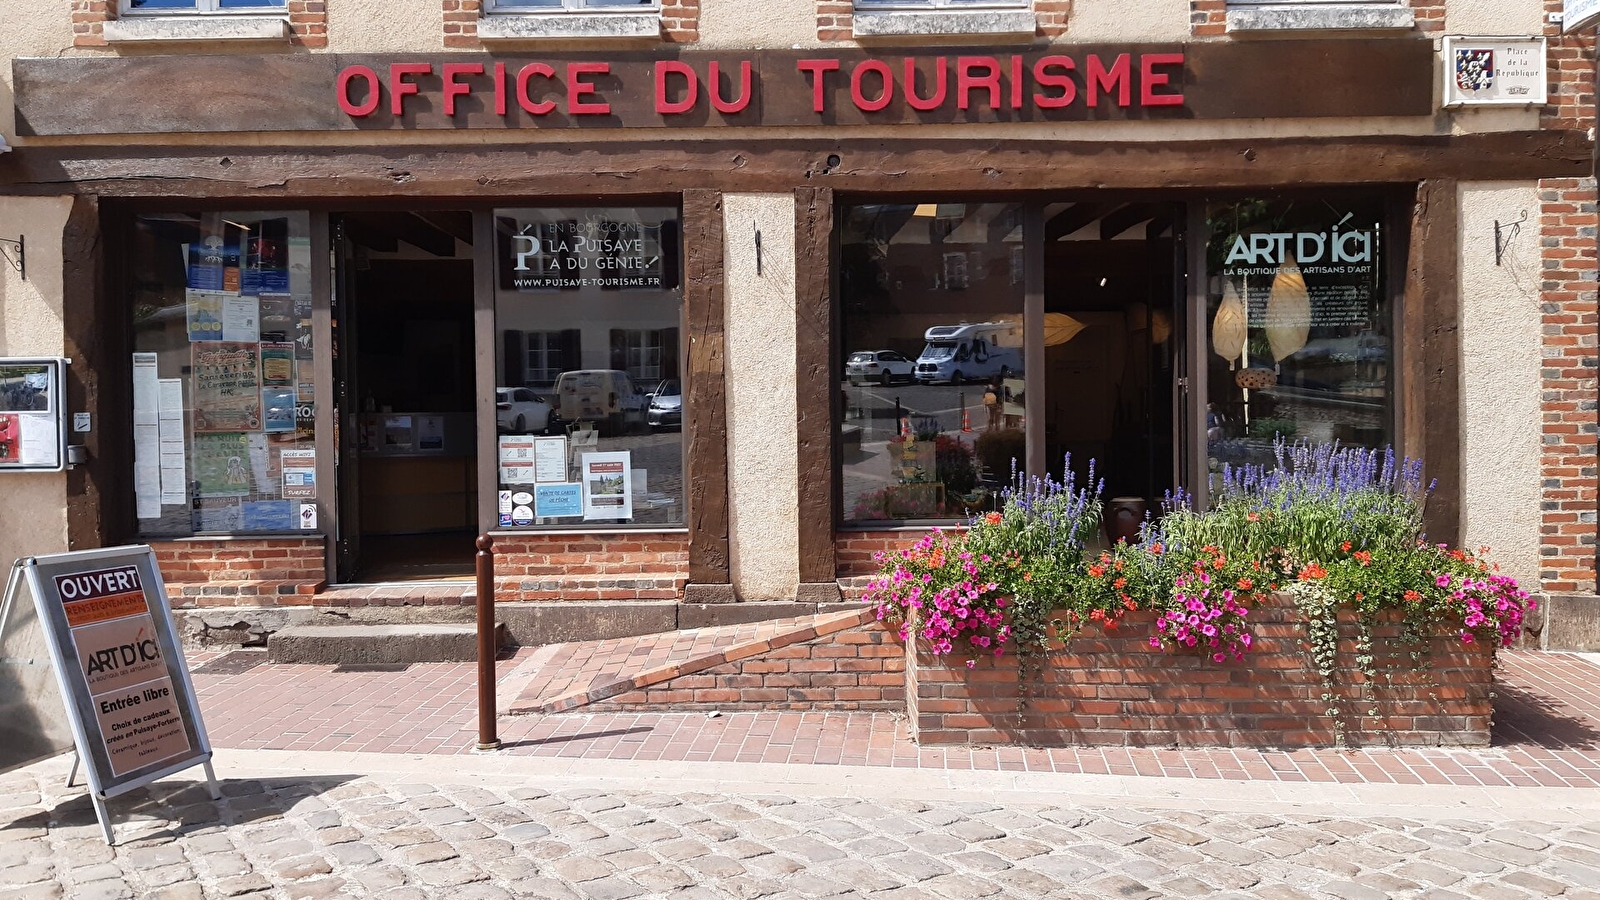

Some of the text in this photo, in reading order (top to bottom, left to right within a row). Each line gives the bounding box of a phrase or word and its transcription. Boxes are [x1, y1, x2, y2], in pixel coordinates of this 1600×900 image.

[1507, 47, 1528, 55] Place
[336, 53, 1184, 117] OFFICE DU TOURISME
[549, 222, 641, 233] EN BOURGOGNE
[549, 239, 569, 253] LA
[1224, 232, 1293, 265] ART
[549, 256, 561, 269] A
[566, 256, 588, 269] DU
[1223, 265, 1371, 276] LA BOUTIQUE DES ARTISANS D'ART
[513, 277, 660, 287] WWW.PUISAYE-TOURISME.FR
[61, 569, 138, 599] OUVERT
[87, 646, 120, 676] ART
[96, 672, 120, 683] BOUTIQUE
[100, 687, 170, 714] Entrée libre
[111, 708, 171, 731] Choix de cadeaux
[106, 734, 124, 744] créés
